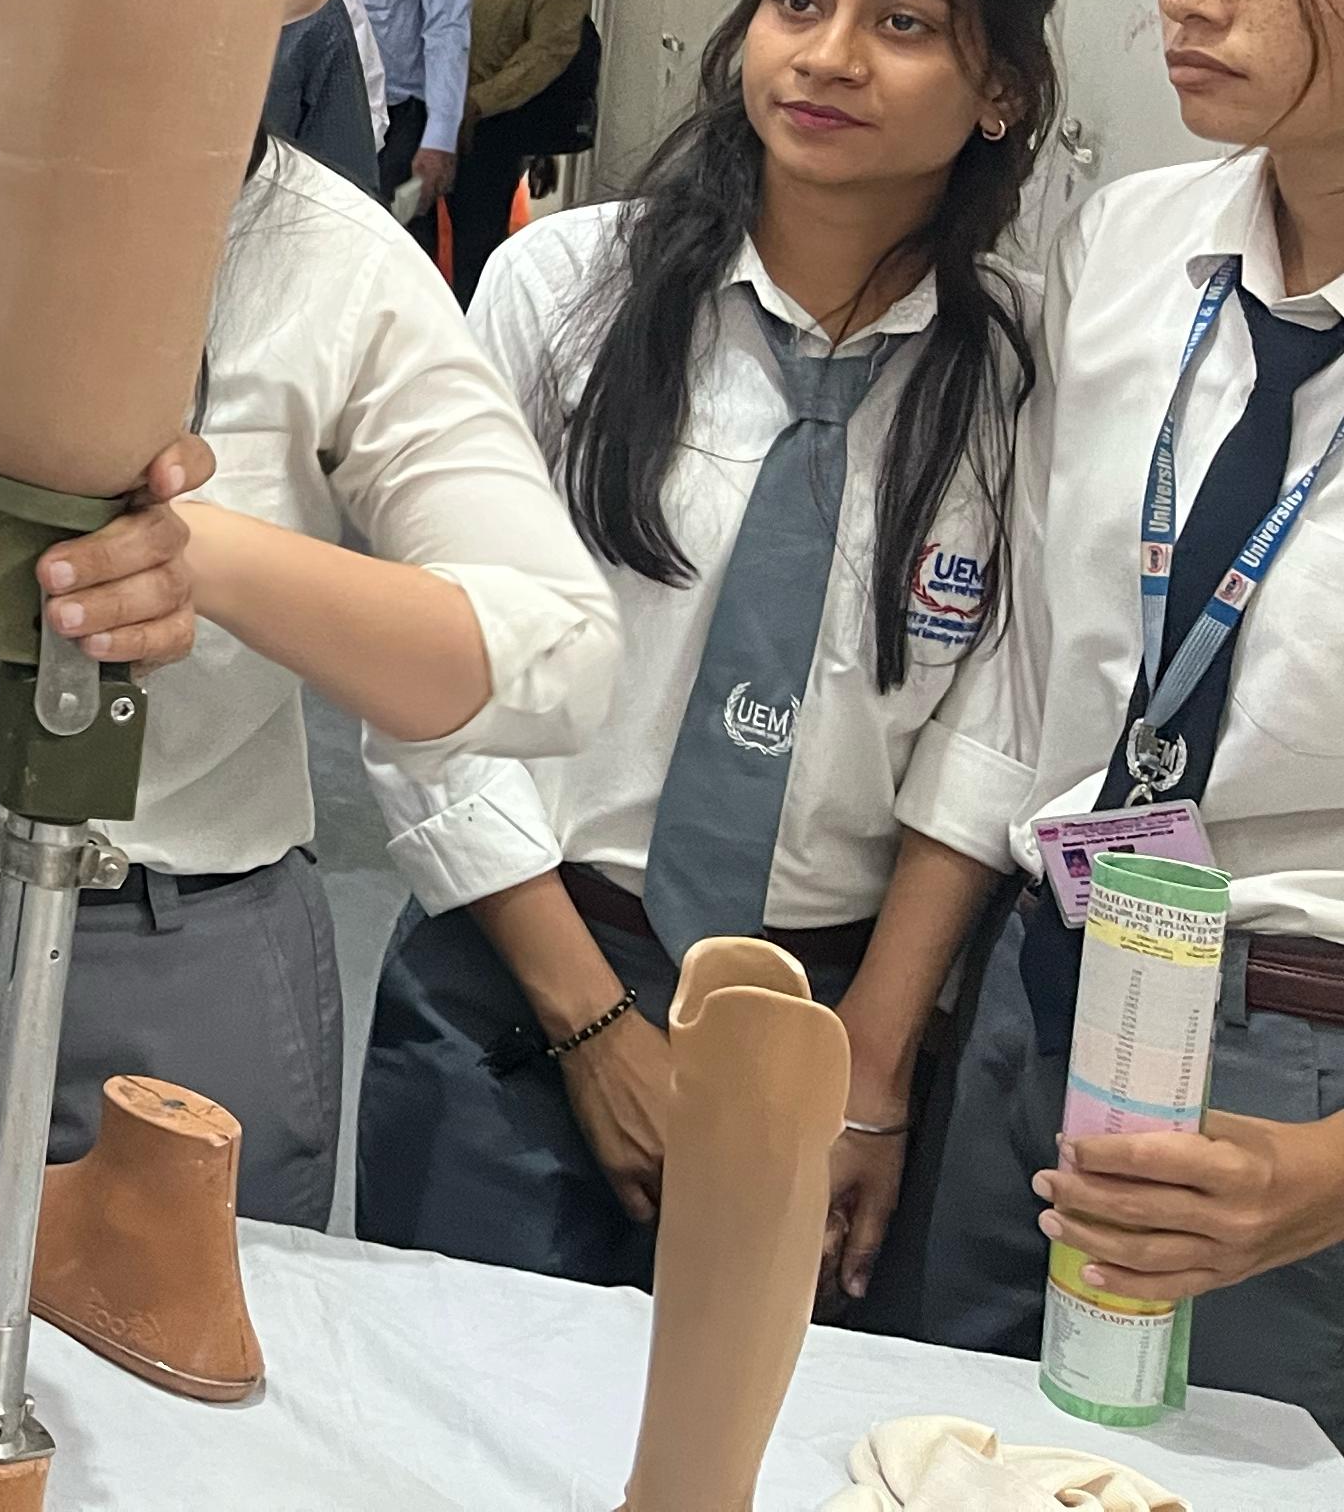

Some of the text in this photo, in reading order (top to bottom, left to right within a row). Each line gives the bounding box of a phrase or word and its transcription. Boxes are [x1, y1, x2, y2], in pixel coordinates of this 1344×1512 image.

[1148, 448, 1173, 533] University
[1240, 489, 1303, 568] University
[737, 696, 790, 735] UEM
[1095, 888, 1163, 917] MAHAVEER
[1157, 928, 1174, 939] TO
[1090, 1309, 1135, 1327] CAMPS
